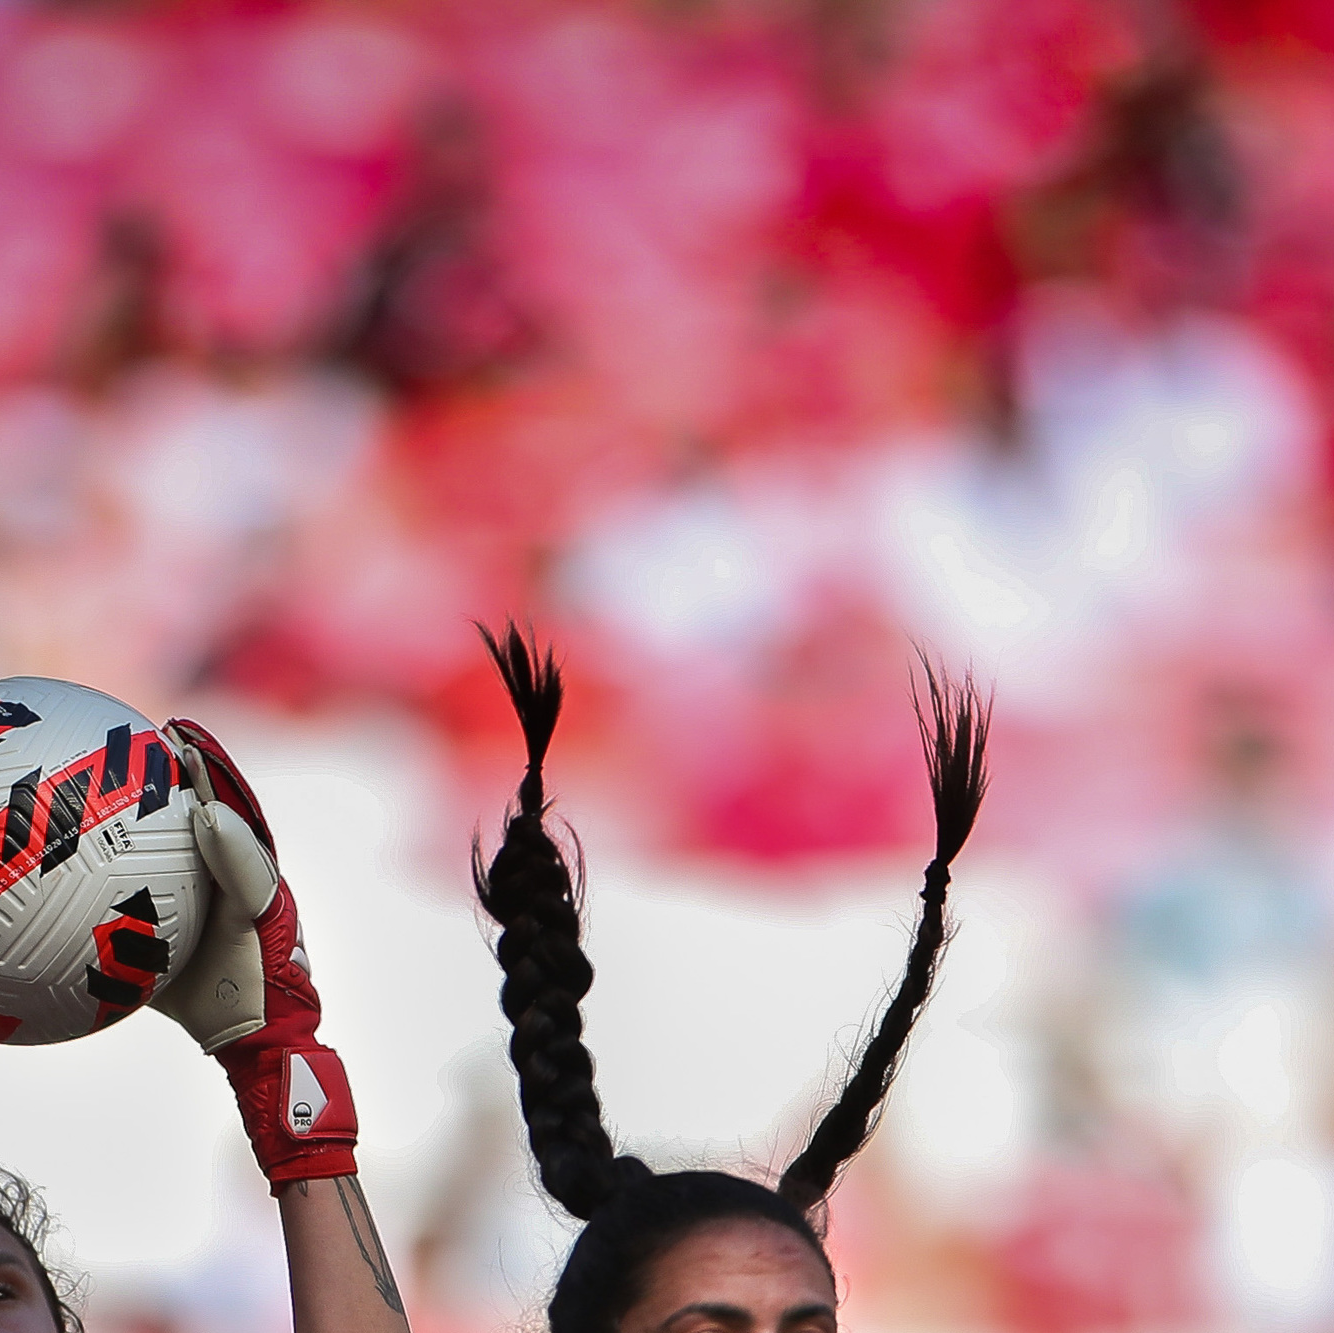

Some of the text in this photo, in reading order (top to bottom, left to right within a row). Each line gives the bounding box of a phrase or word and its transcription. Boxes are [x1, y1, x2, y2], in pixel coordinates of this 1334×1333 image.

[63, 826, 79, 840] 415
[113, 821, 132, 850] FIFA
[293, 1118, 313, 1127] PRO
